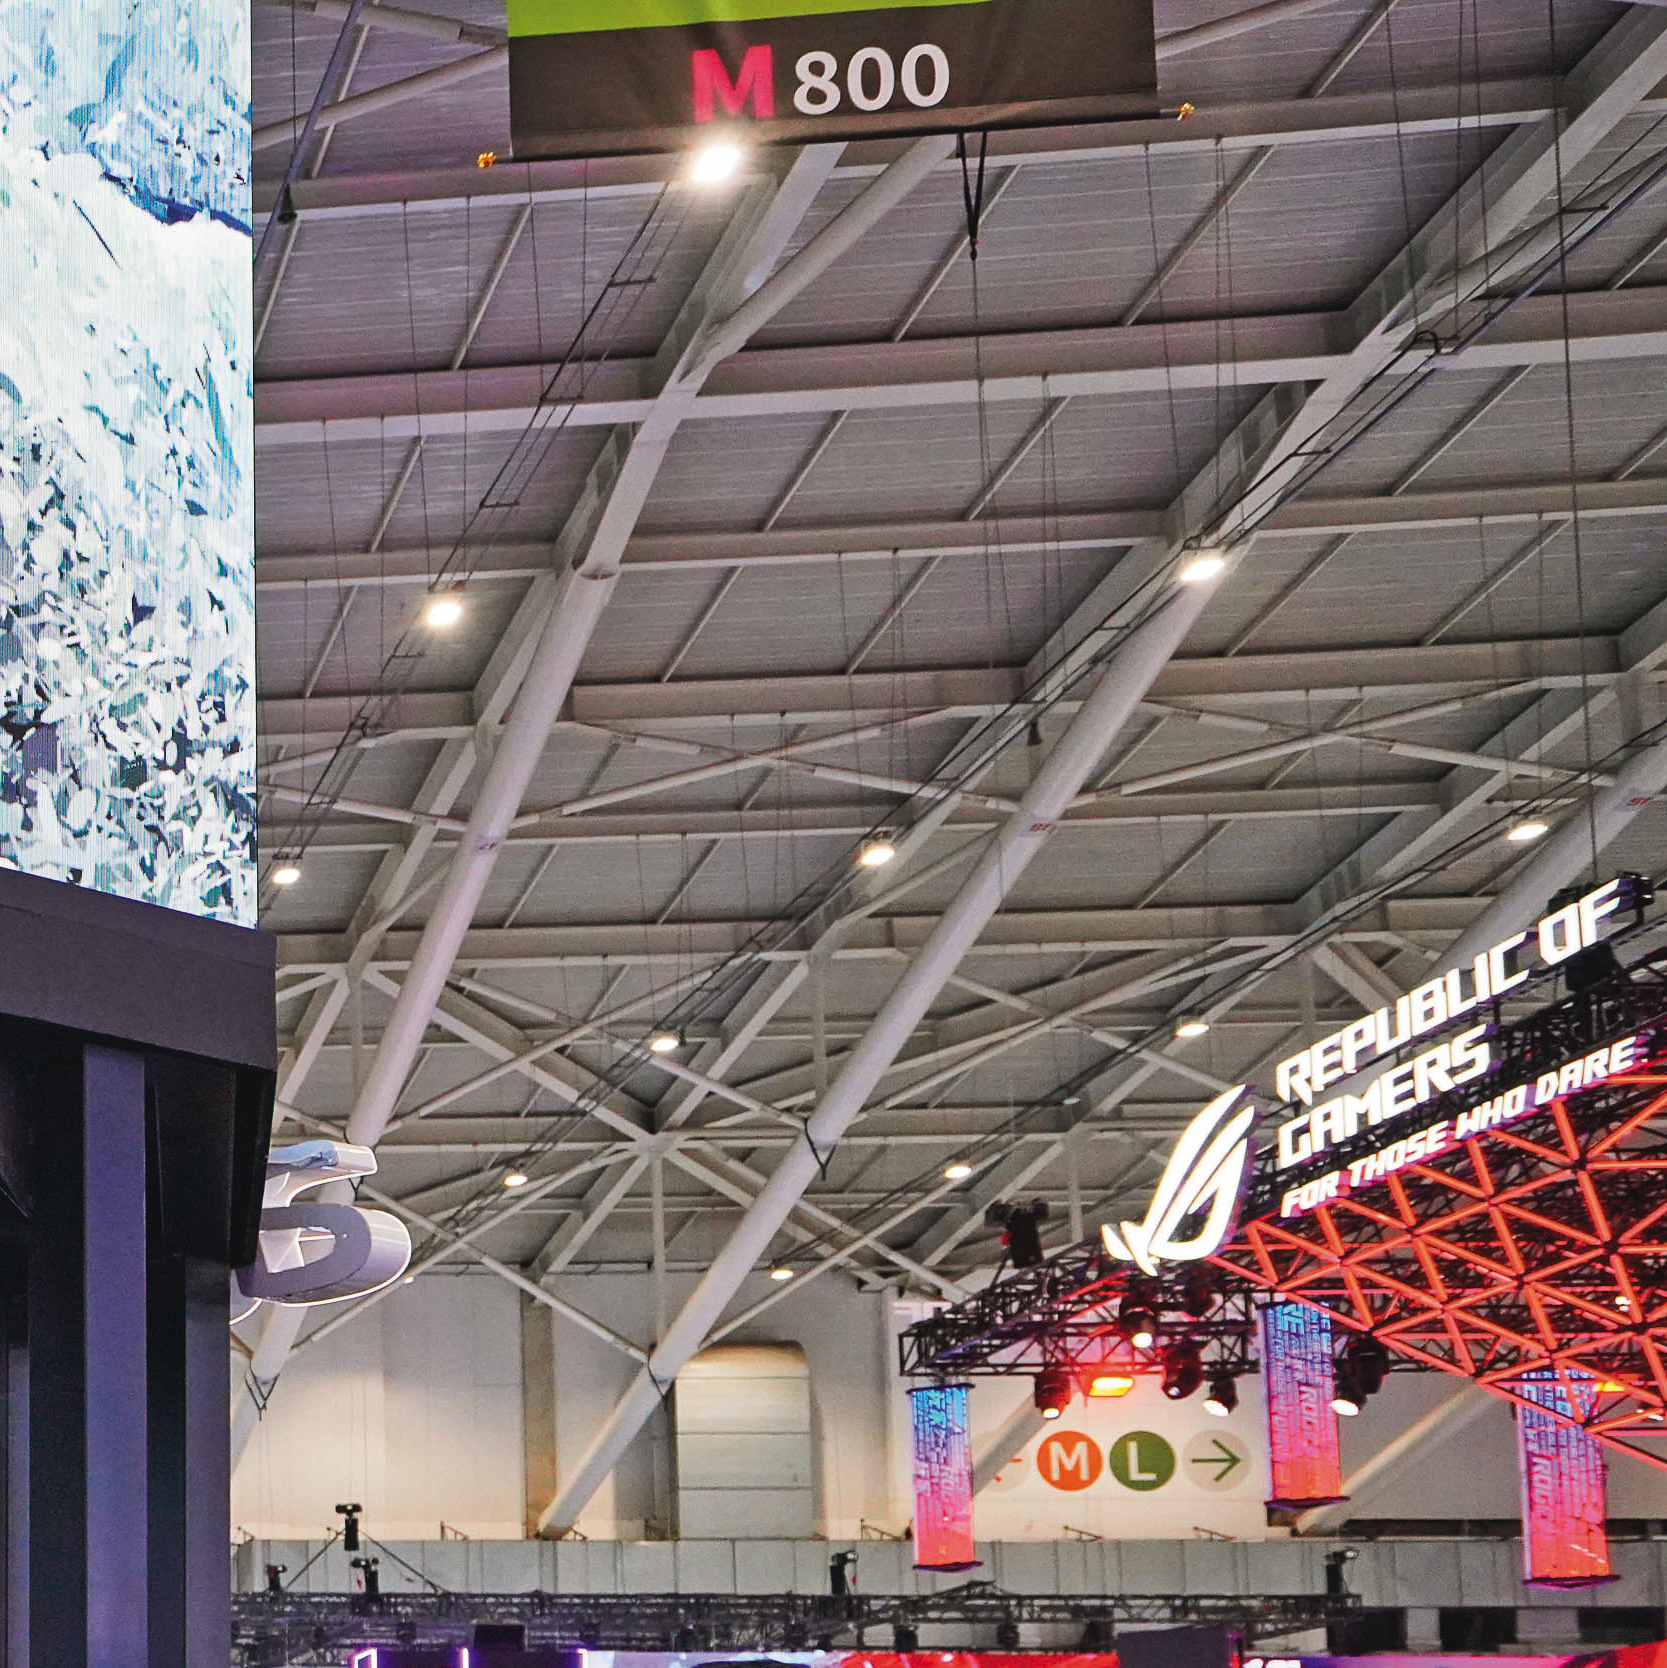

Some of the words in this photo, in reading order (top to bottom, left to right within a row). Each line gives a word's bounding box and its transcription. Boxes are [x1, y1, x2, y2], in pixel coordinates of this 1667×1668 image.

[691, 45, 776, 122] M
[793, 43, 951, 116] 800
[1275, 931, 1531, 1107] REPUBLIC
[1538, 877, 1623, 966] OF
[1278, 1023, 1494, 1169] GAMERS
[1280, 1169, 1341, 1219] FOR
[1347, 1118, 1449, 1188] THOSE
[1455, 1083, 1528, 1140] WHO
[1048, 1441, 1090, 1481] M
[1126, 1440, 1157, 1482] L
